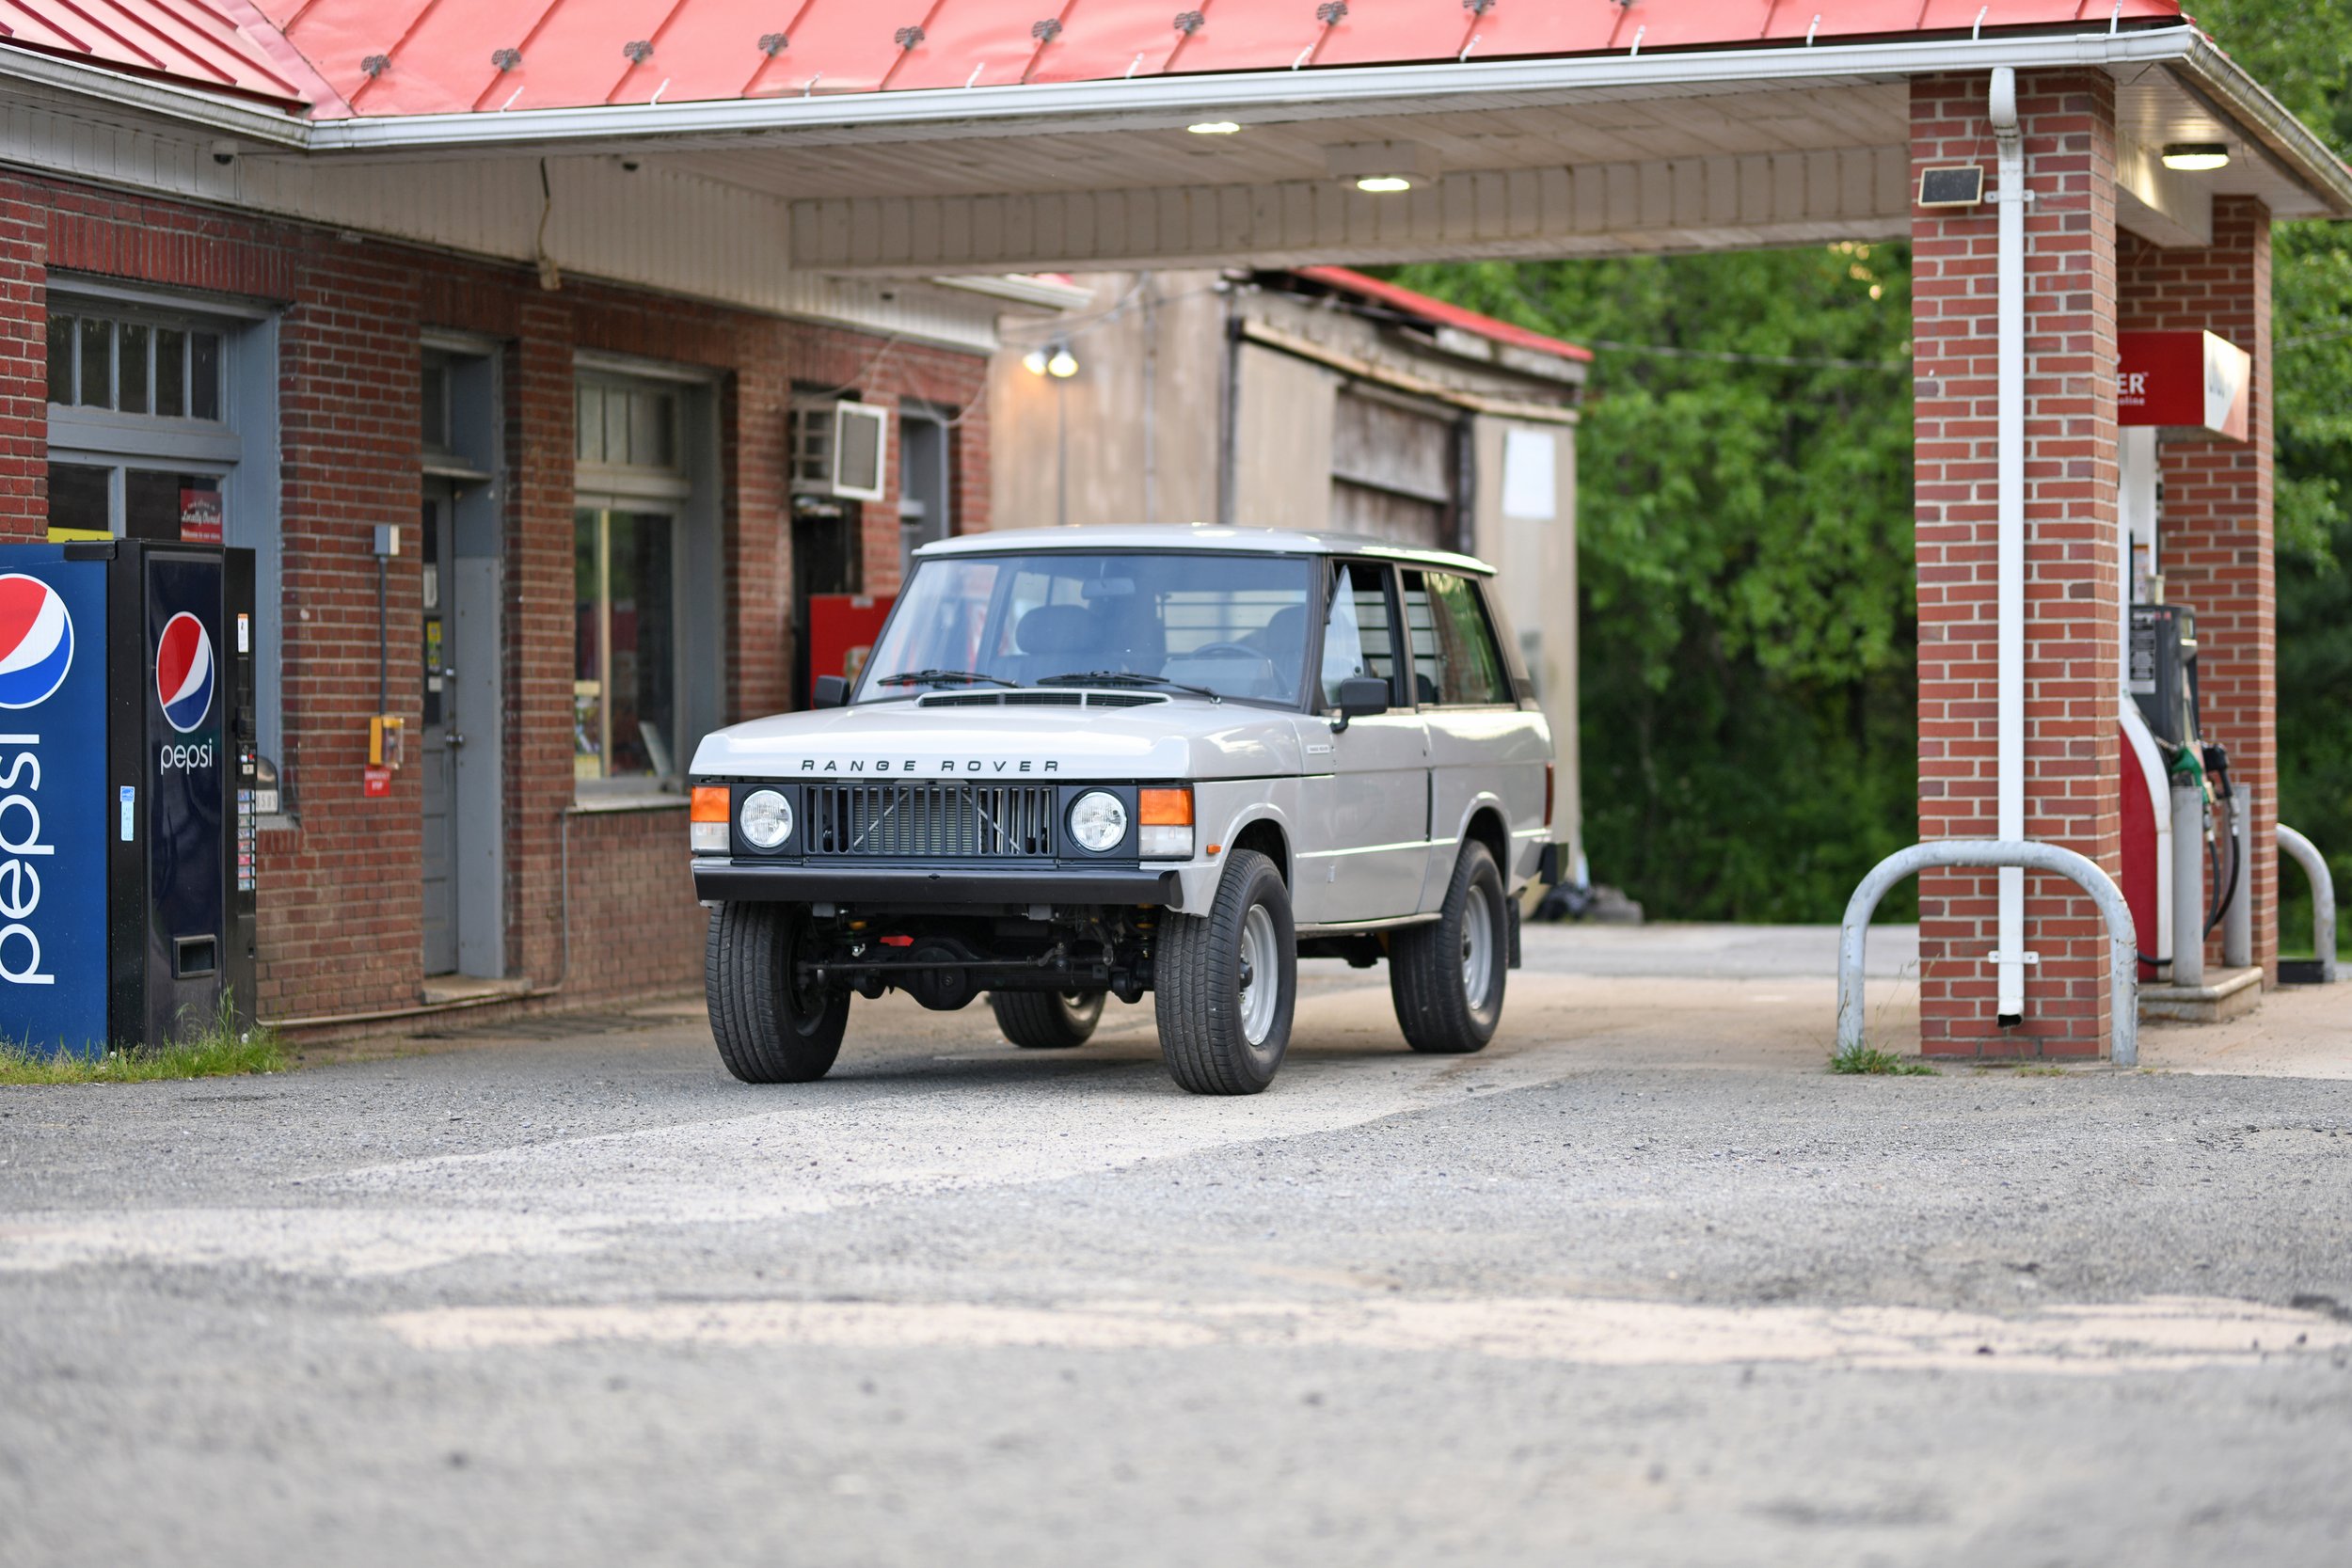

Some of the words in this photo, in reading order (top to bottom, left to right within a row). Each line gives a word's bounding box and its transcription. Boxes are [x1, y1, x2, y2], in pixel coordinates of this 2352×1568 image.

[161, 738, 213, 775] pepsi
[801, 759, 916, 771] RANGE
[941, 760, 1058, 772] ROVER
[0, 734, 55, 984] pepsi
